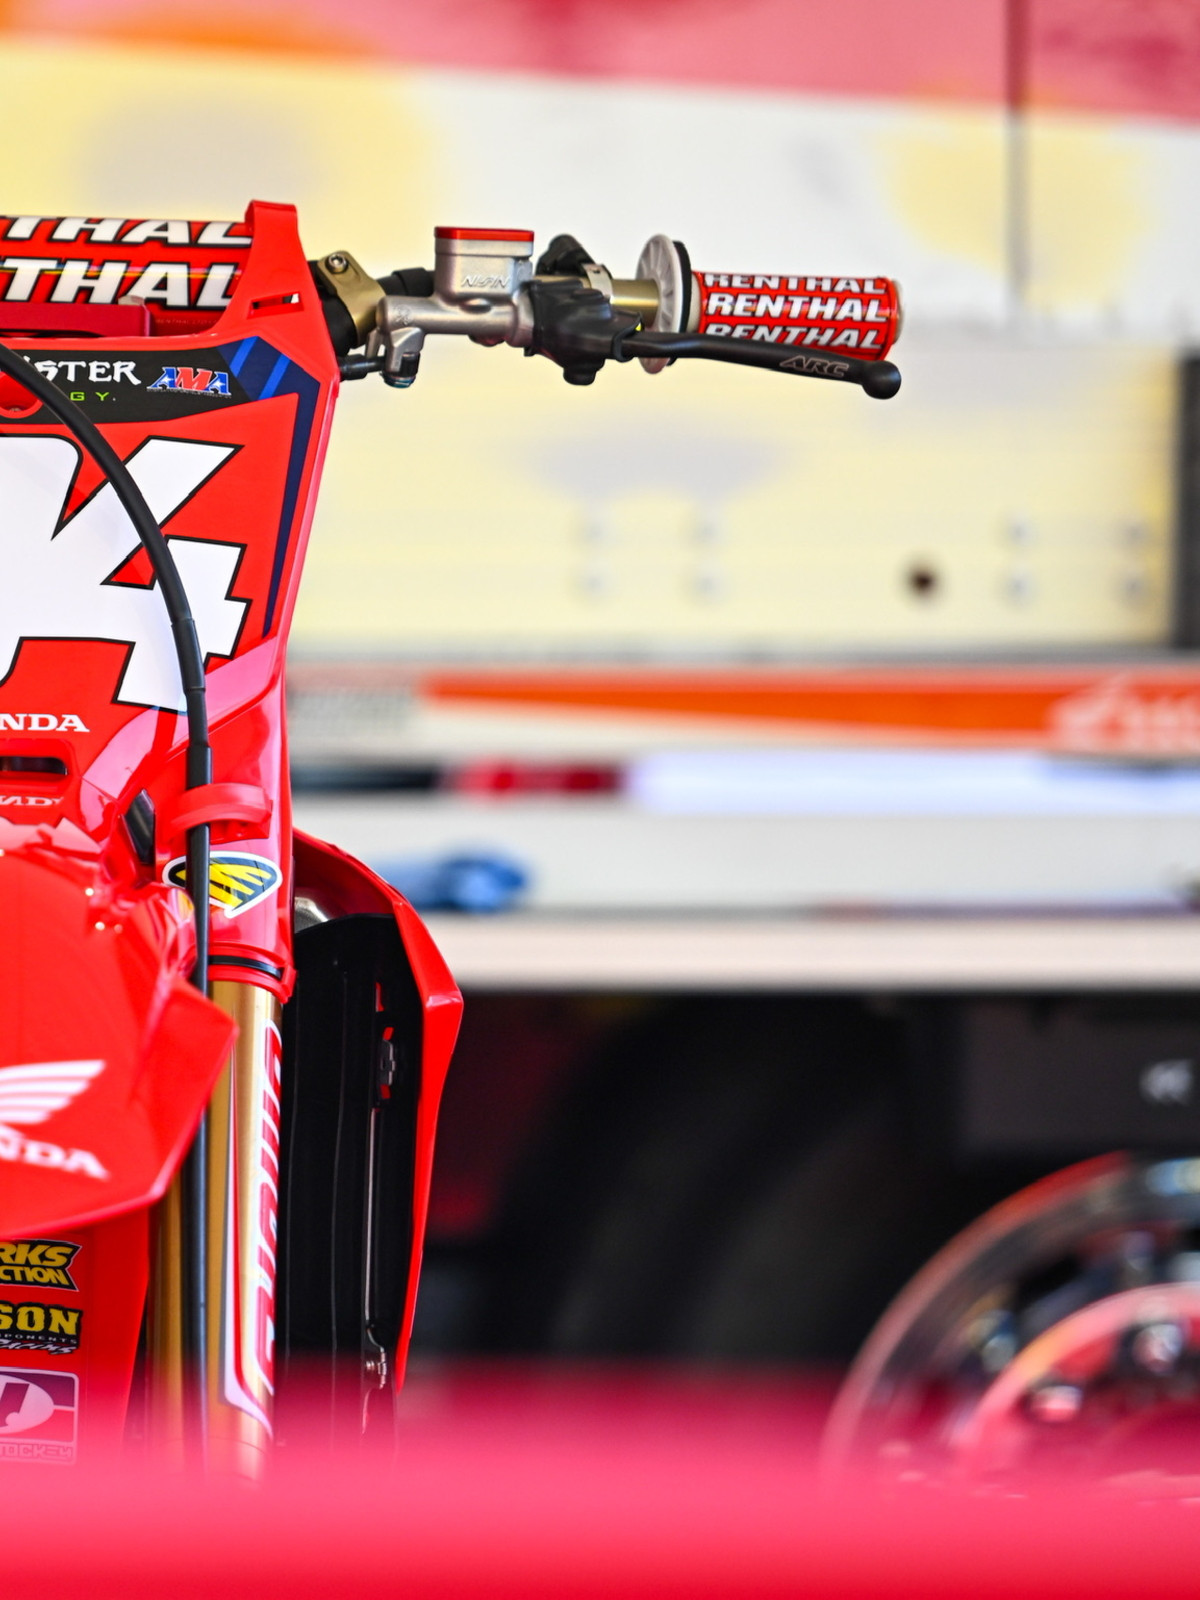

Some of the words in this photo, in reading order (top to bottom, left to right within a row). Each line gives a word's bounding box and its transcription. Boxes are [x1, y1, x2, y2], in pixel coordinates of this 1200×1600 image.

[704, 273, 886, 294] RENTHAL
[705, 292, 888, 322] RENTHAL
[779, 355, 849, 378] ARC
[146, 367, 232, 396] AMA
